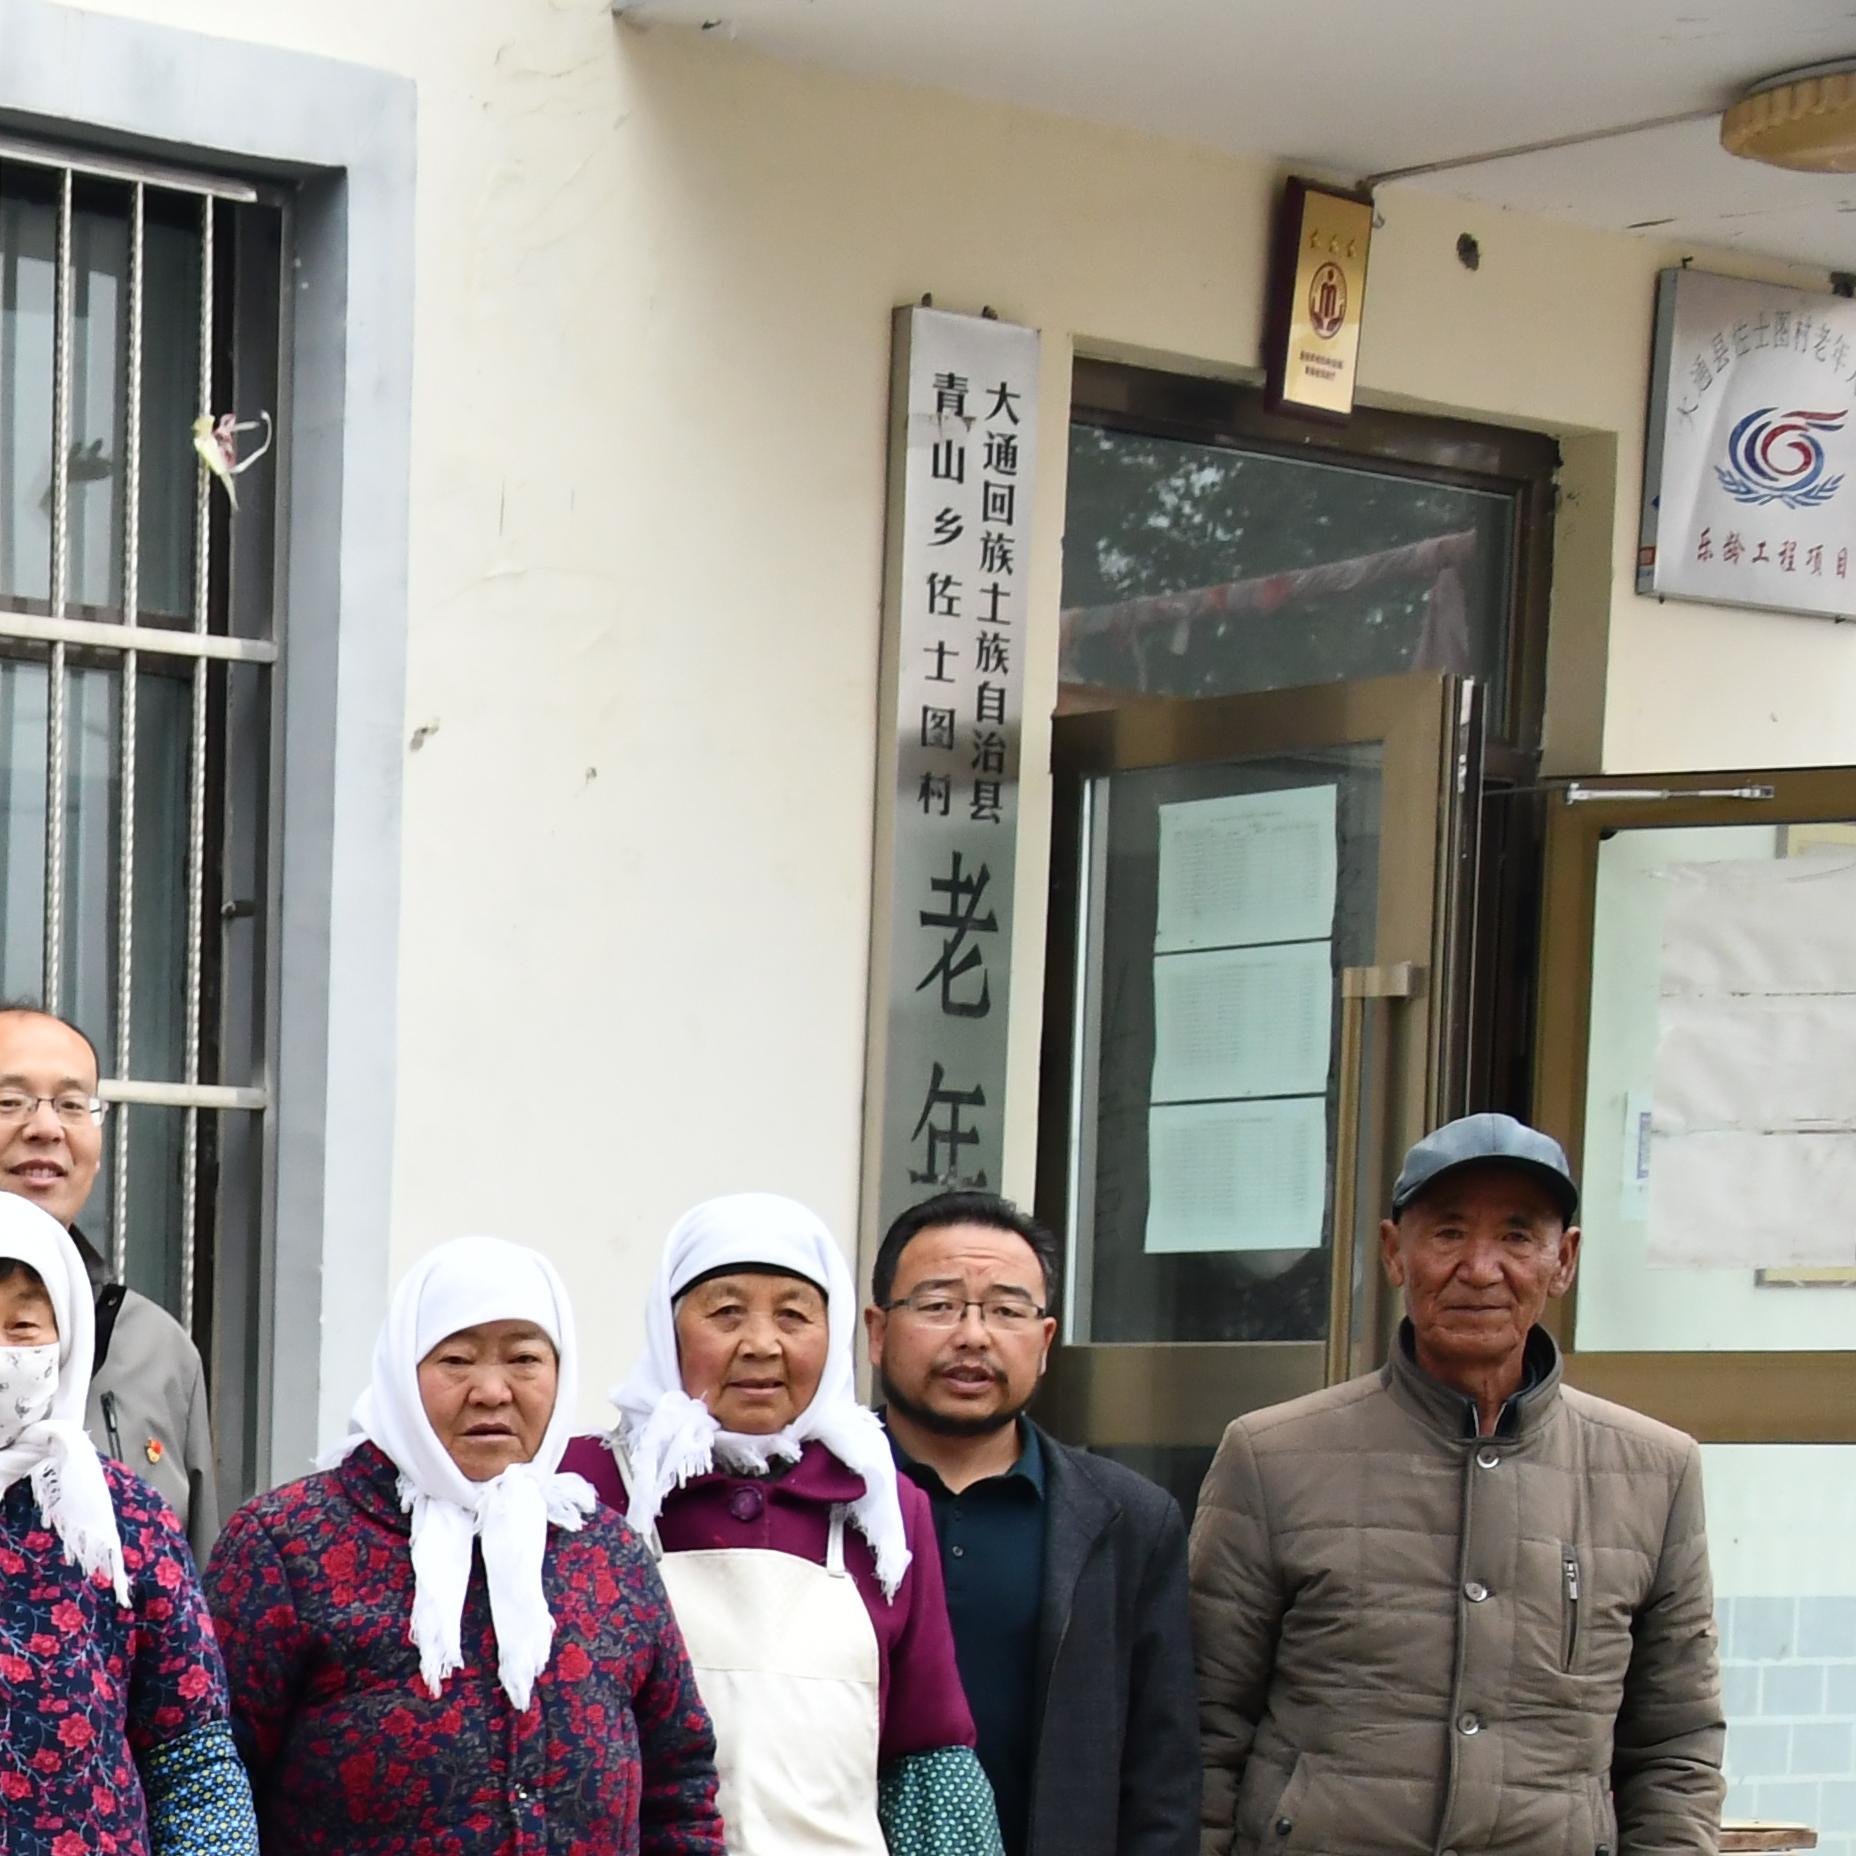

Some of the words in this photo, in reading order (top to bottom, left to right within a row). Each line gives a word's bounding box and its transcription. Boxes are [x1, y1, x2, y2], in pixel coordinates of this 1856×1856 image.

[917, 372, 970, 817] 青山乡佐士图村
[968, 381, 1021, 825] 大通回族土族自治县
[1696, 526, 1849, 580] 乐龄工程项目
